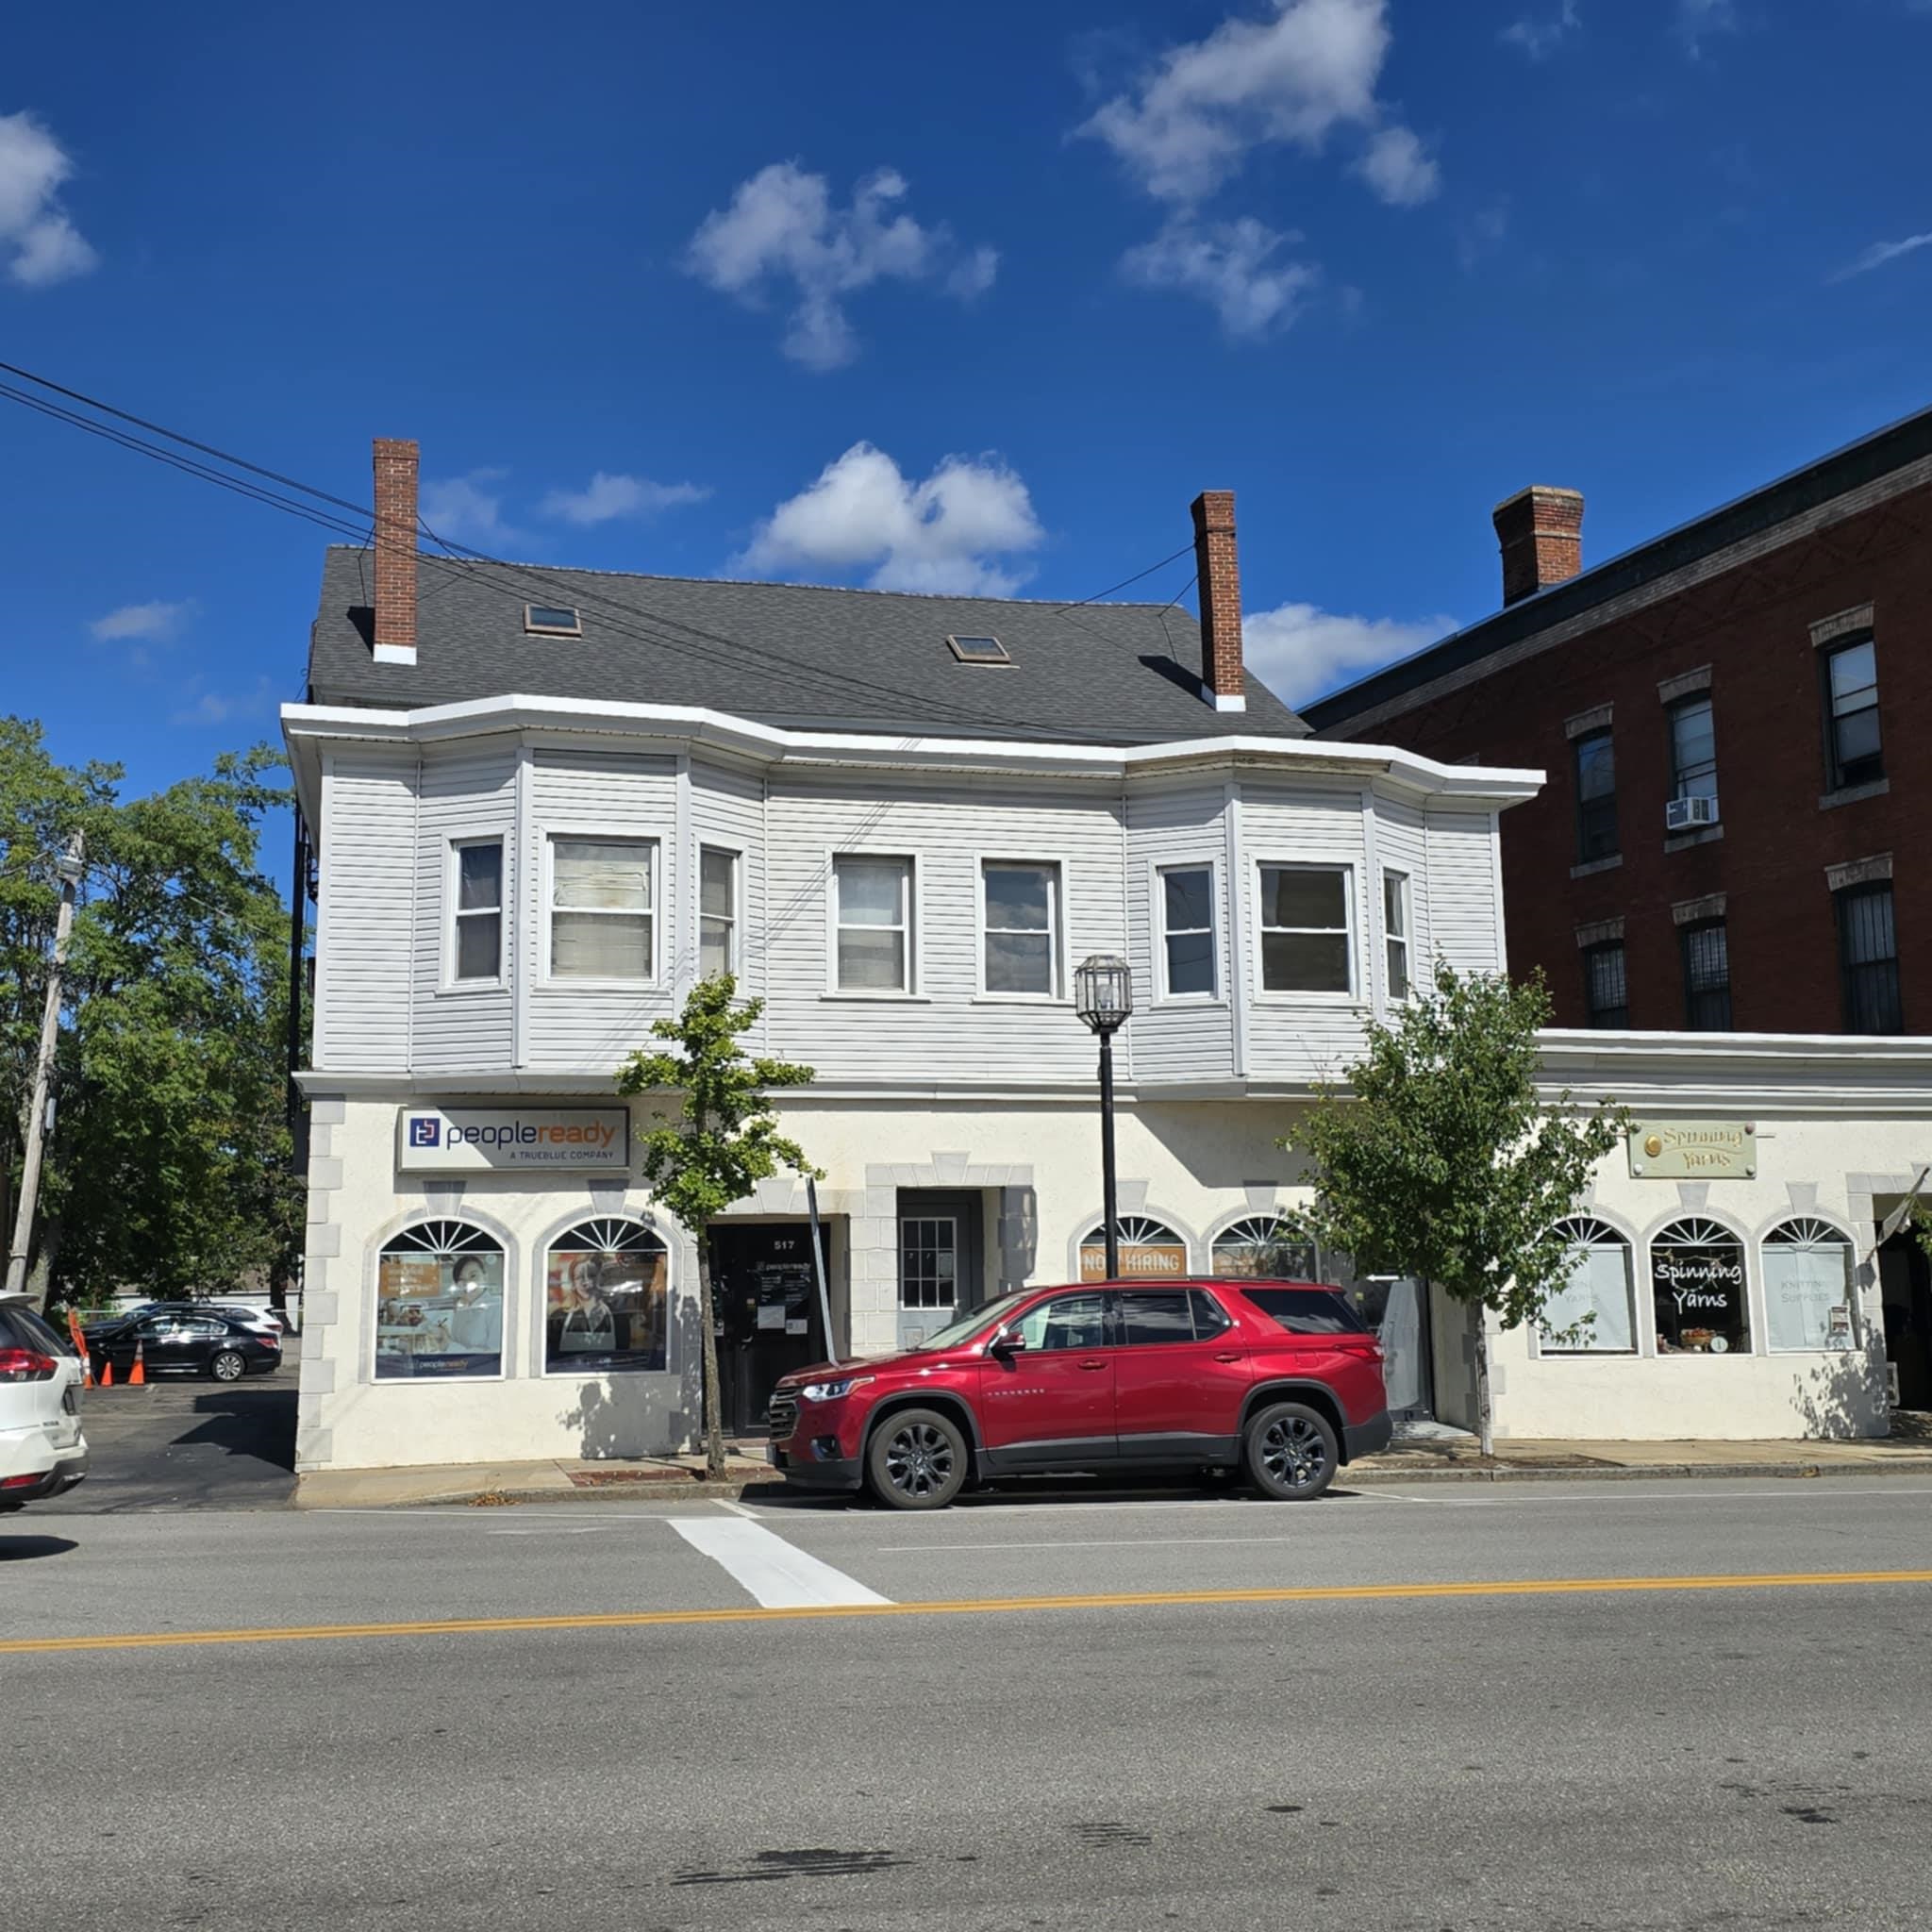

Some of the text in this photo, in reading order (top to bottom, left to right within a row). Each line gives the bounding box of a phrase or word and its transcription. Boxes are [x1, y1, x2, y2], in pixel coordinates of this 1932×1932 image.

[447, 1120, 614, 1150] peopleready
[1663, 1127, 1742, 1148] Spinning
[510, 1151, 614, 1160] A TRUEBLUE COMPANY
[1683, 1152, 1731, 1170] Yarns
[774, 1240, 795, 1250] 517
[1125, 1253, 1179, 1272] HIRING
[1654, 1260, 1742, 1285] Spinning
[1673, 1289, 1728, 1315] Yarns
